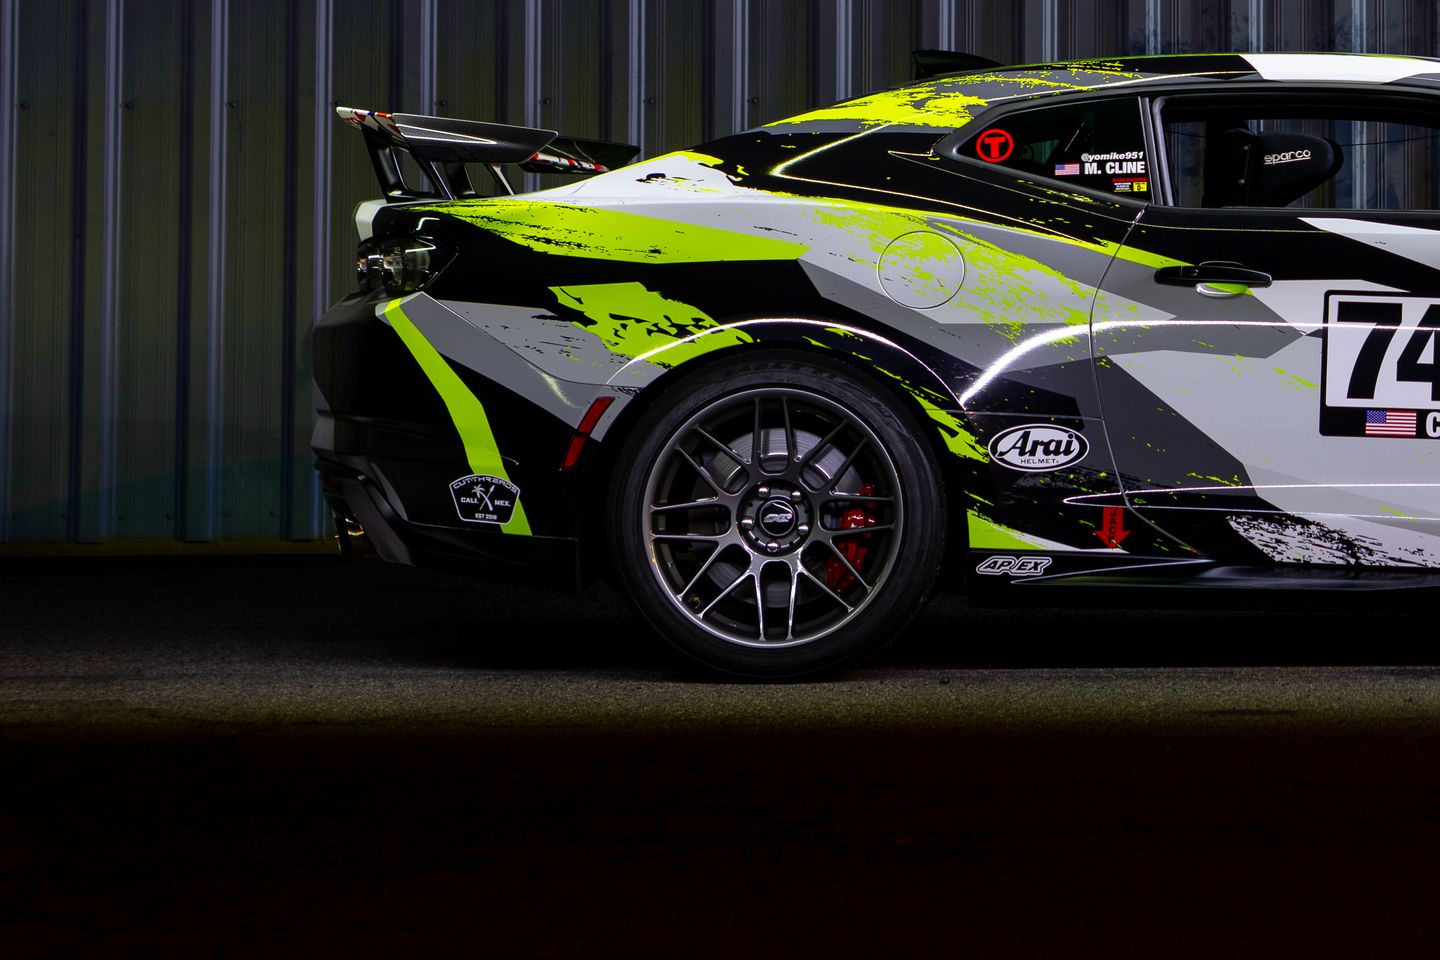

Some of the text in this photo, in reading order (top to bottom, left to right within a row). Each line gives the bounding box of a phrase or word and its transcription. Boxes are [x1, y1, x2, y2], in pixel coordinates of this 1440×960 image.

[1081, 151, 1144, 163] @yomike951
[1263, 149, 1311, 165] sparco
[1084, 161, 1146, 175] M. CLINE
[995, 430, 1076, 458] Arai
[983, 559, 1047, 572] APEX
